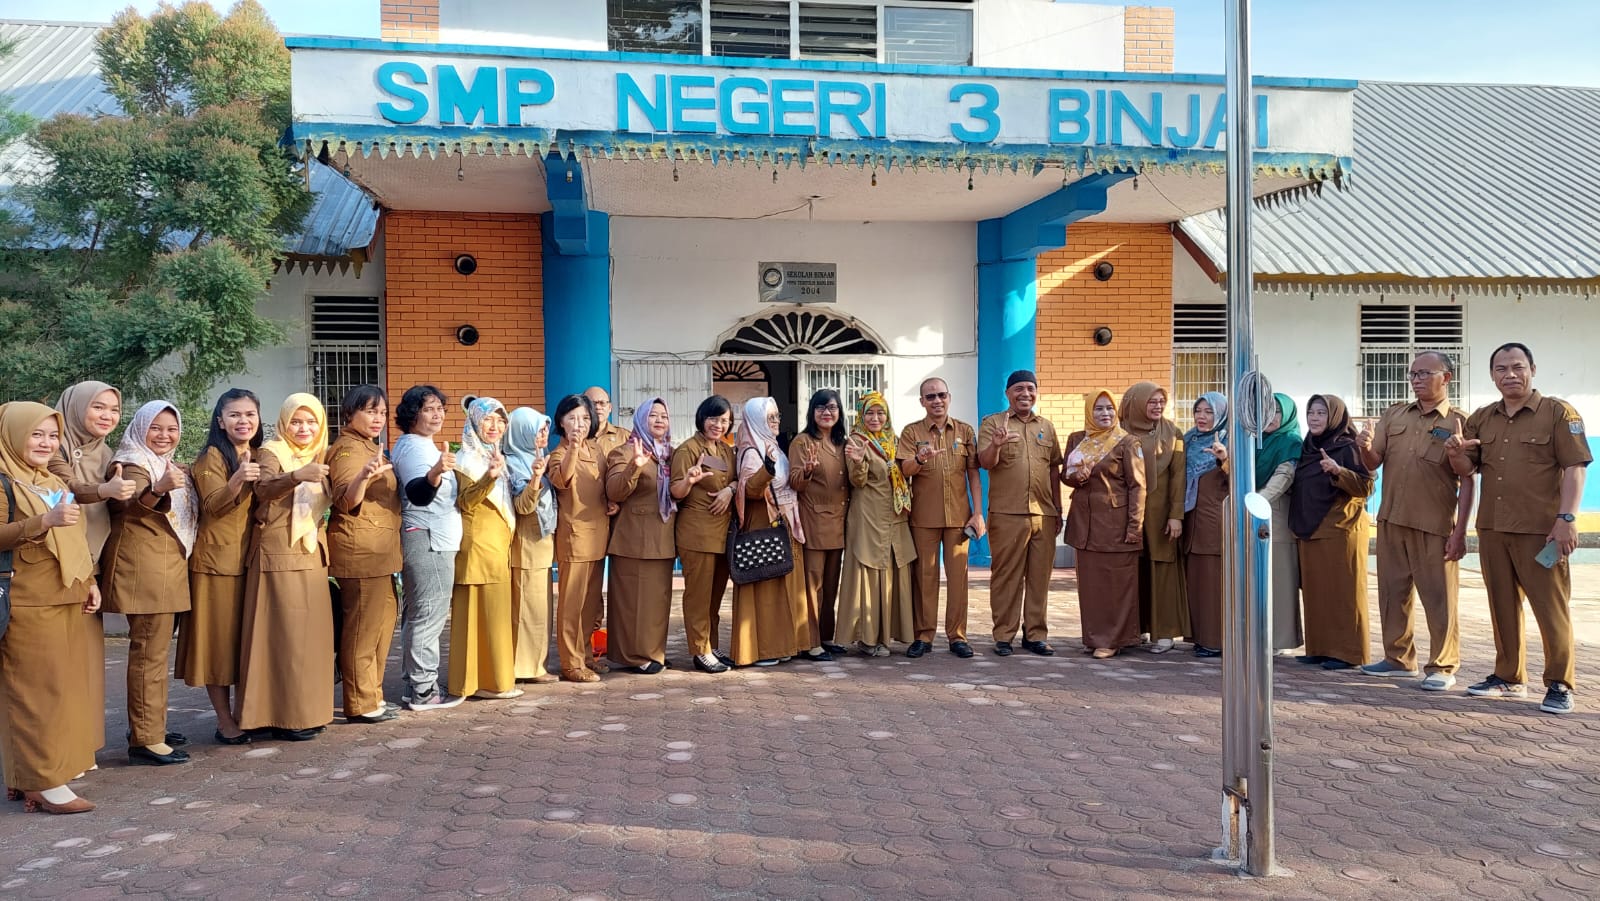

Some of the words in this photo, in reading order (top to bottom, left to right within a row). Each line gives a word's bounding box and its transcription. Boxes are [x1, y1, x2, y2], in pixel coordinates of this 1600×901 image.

[376, 61, 555, 126] SMP
[616, 72, 887, 139] NEGERI
[948, 82, 1001, 143] 3
[801, 286, 820, 295] 2004
